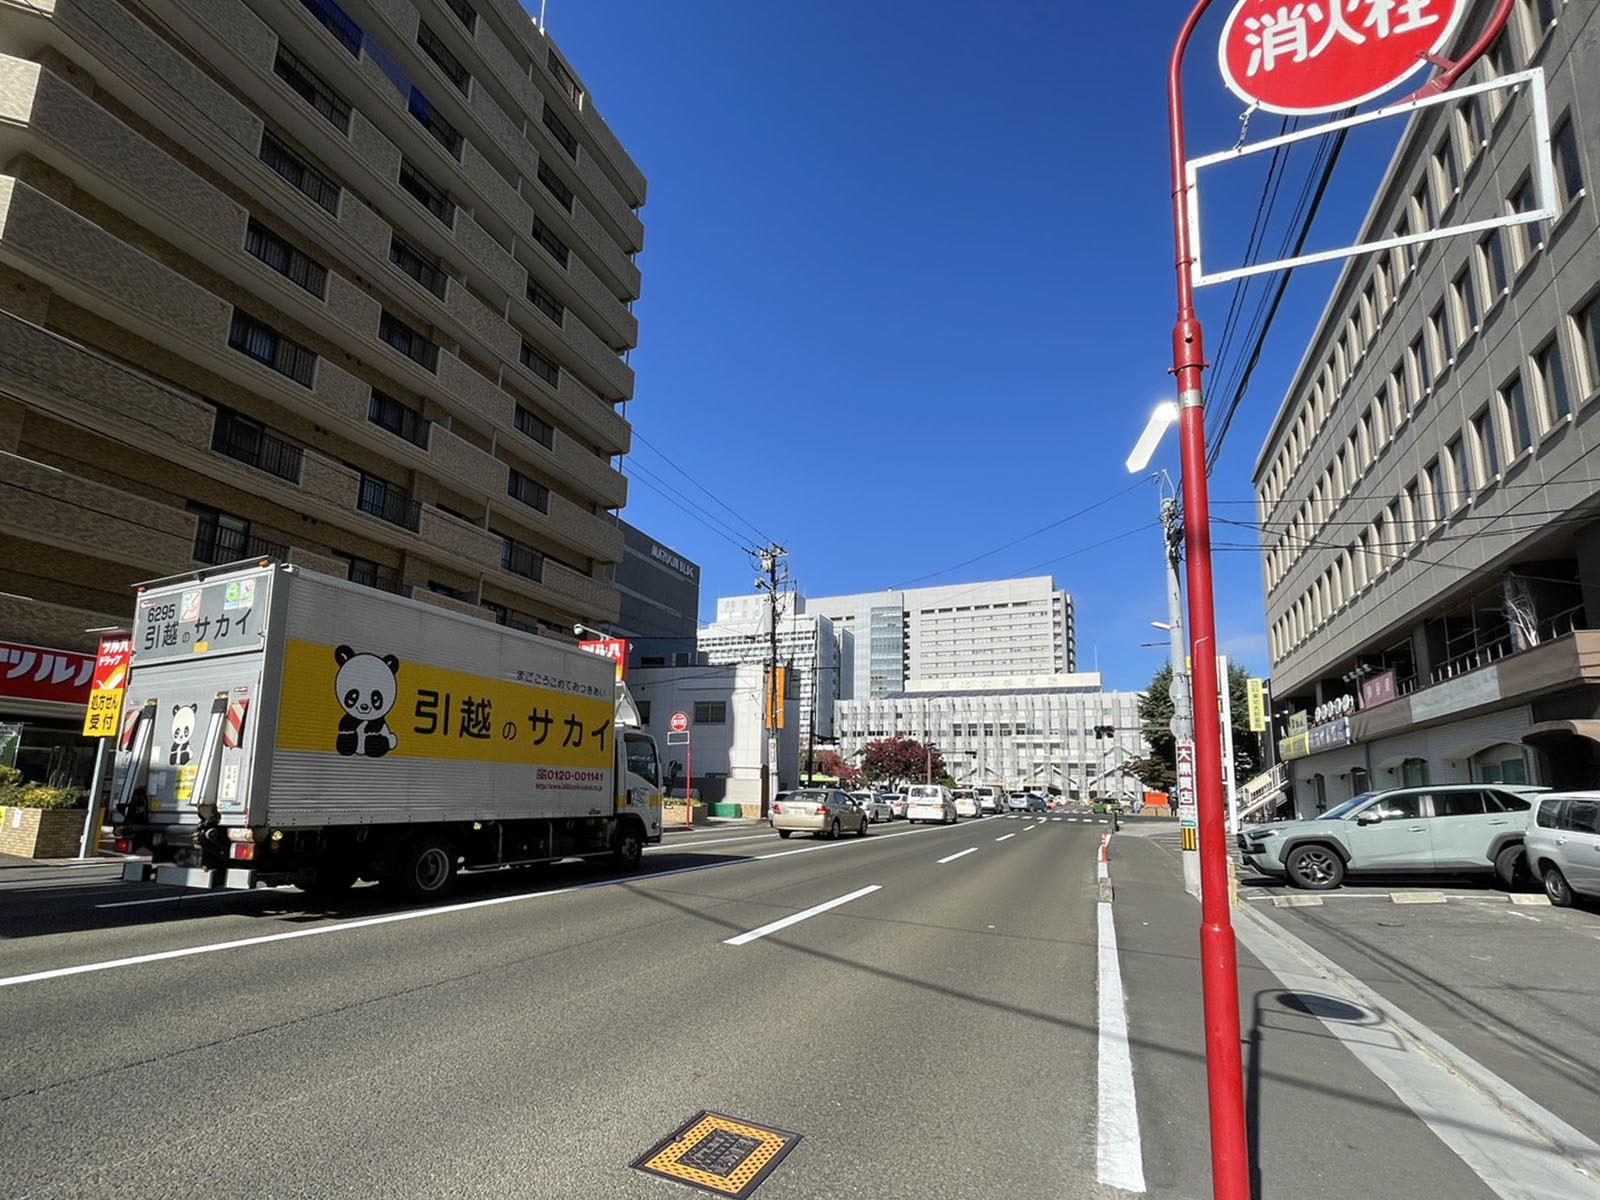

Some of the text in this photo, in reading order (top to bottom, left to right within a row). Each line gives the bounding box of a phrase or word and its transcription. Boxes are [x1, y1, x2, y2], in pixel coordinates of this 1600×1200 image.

[147, 603, 176, 623] 6295
[144, 607, 253, 650] 引越のサカイ
[102, 640, 129, 655] ツルハ
[516, 670, 606, 696] まごころこめておつきあい
[90, 694, 119, 711] 処方せん
[88, 713, 114, 730] 受付
[413, 689, 611, 752] 引越のサカイ
